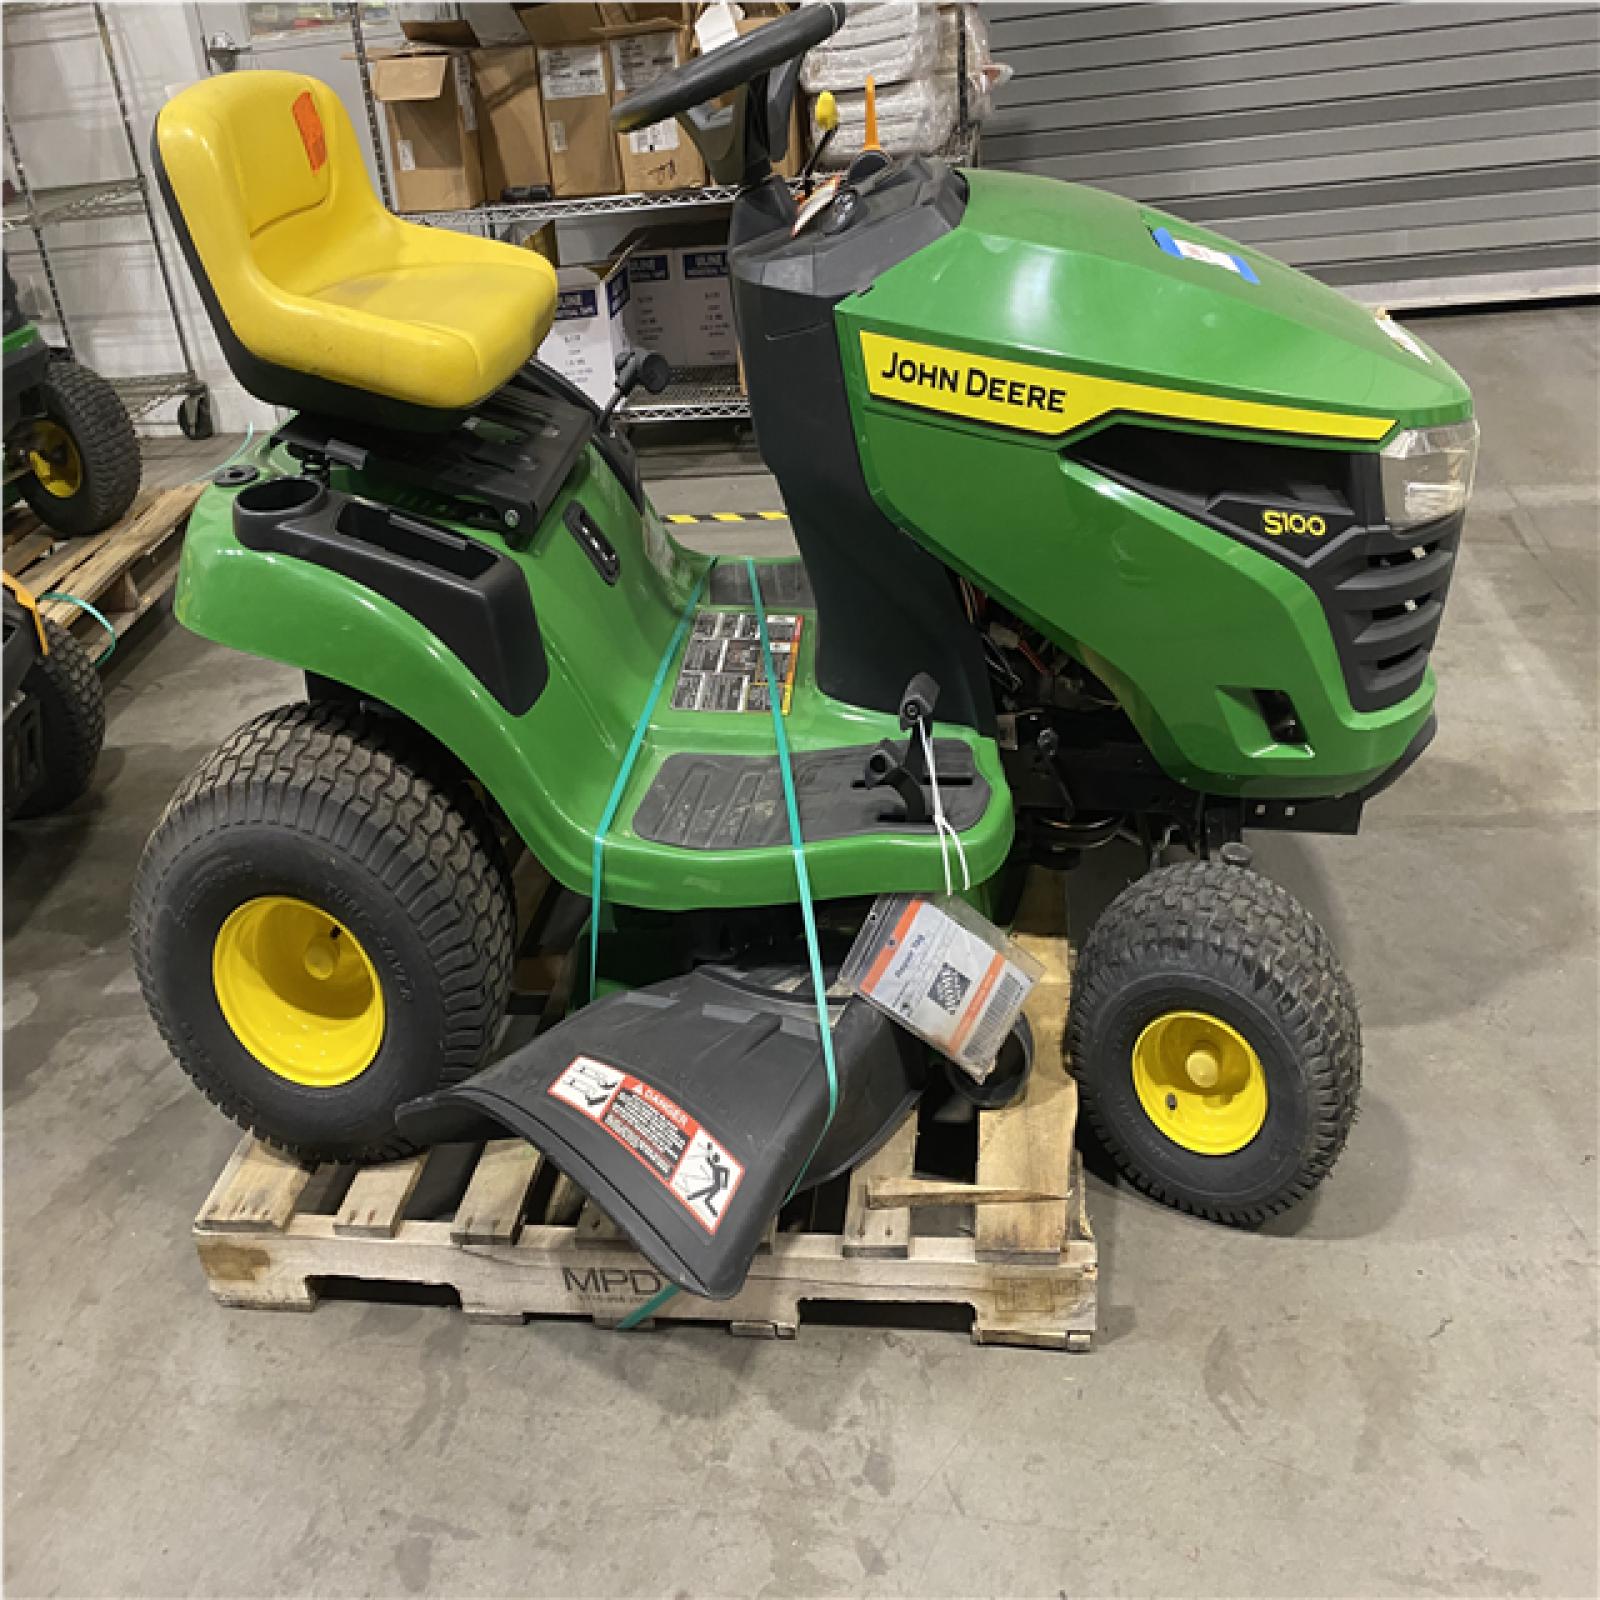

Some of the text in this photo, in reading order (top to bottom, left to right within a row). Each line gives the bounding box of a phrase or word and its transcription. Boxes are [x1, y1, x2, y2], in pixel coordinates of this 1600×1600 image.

[881, 352, 1067, 413] JOHN DEERE
[1263, 509, 1326, 535] S100
[562, 1267, 661, 1295] MPD
